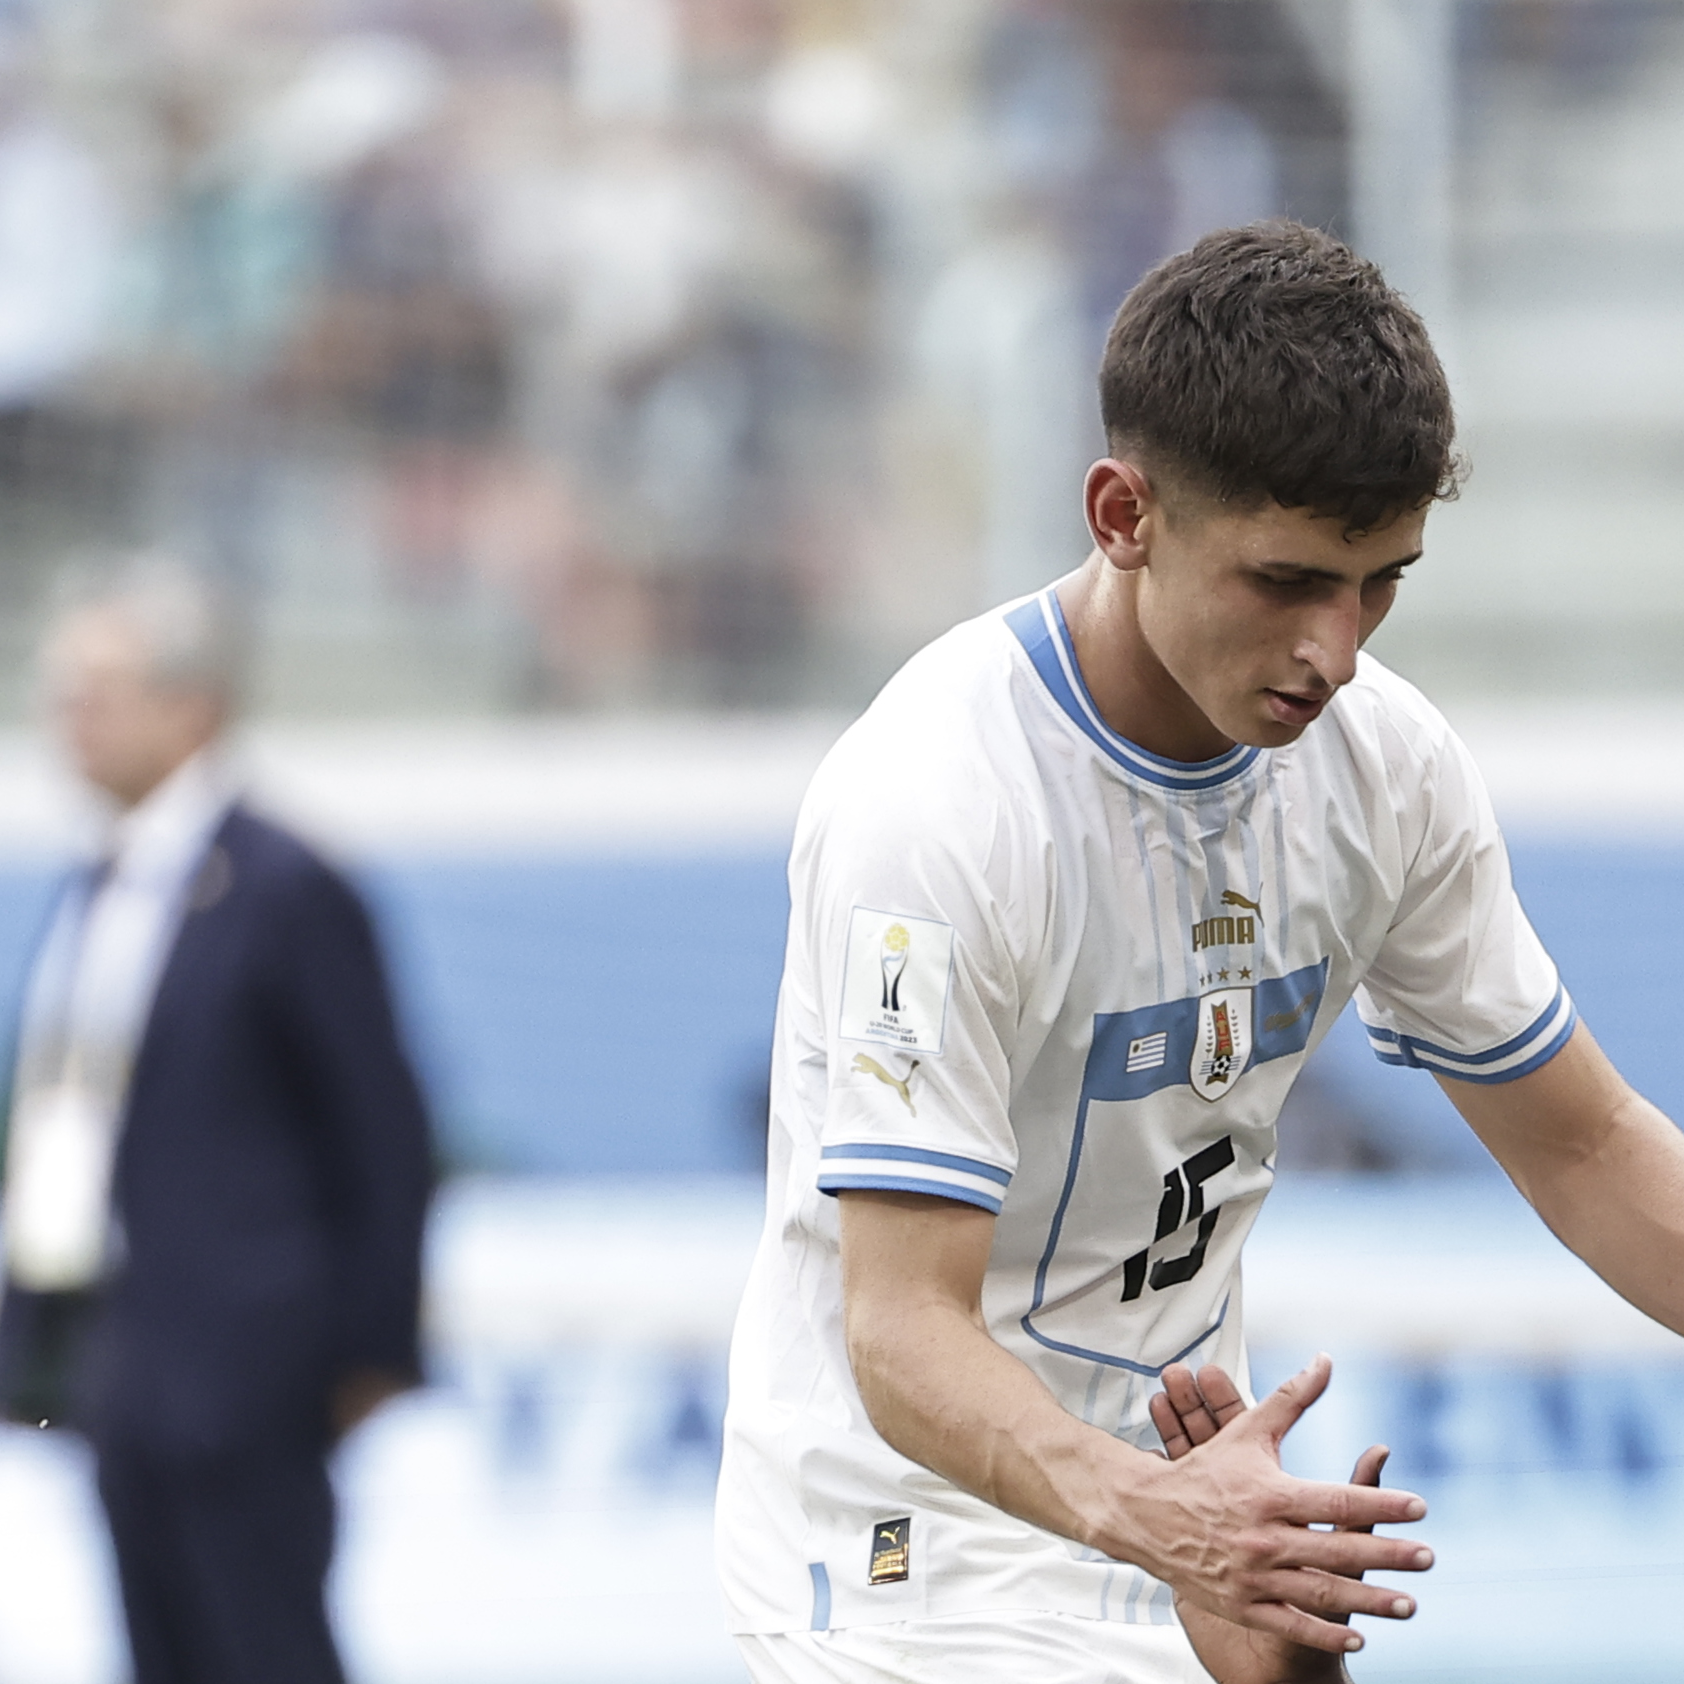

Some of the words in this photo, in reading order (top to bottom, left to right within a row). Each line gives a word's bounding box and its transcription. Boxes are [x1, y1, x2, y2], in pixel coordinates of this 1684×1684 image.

[1192, 916, 1255, 952] PUMA
[883, 1013, 899, 1024] FIFA
[1216, 1010, 1231, 1051] AUF
[900, 1035, 918, 1043] 2023
[1120, 1134, 1235, 1302] 15
